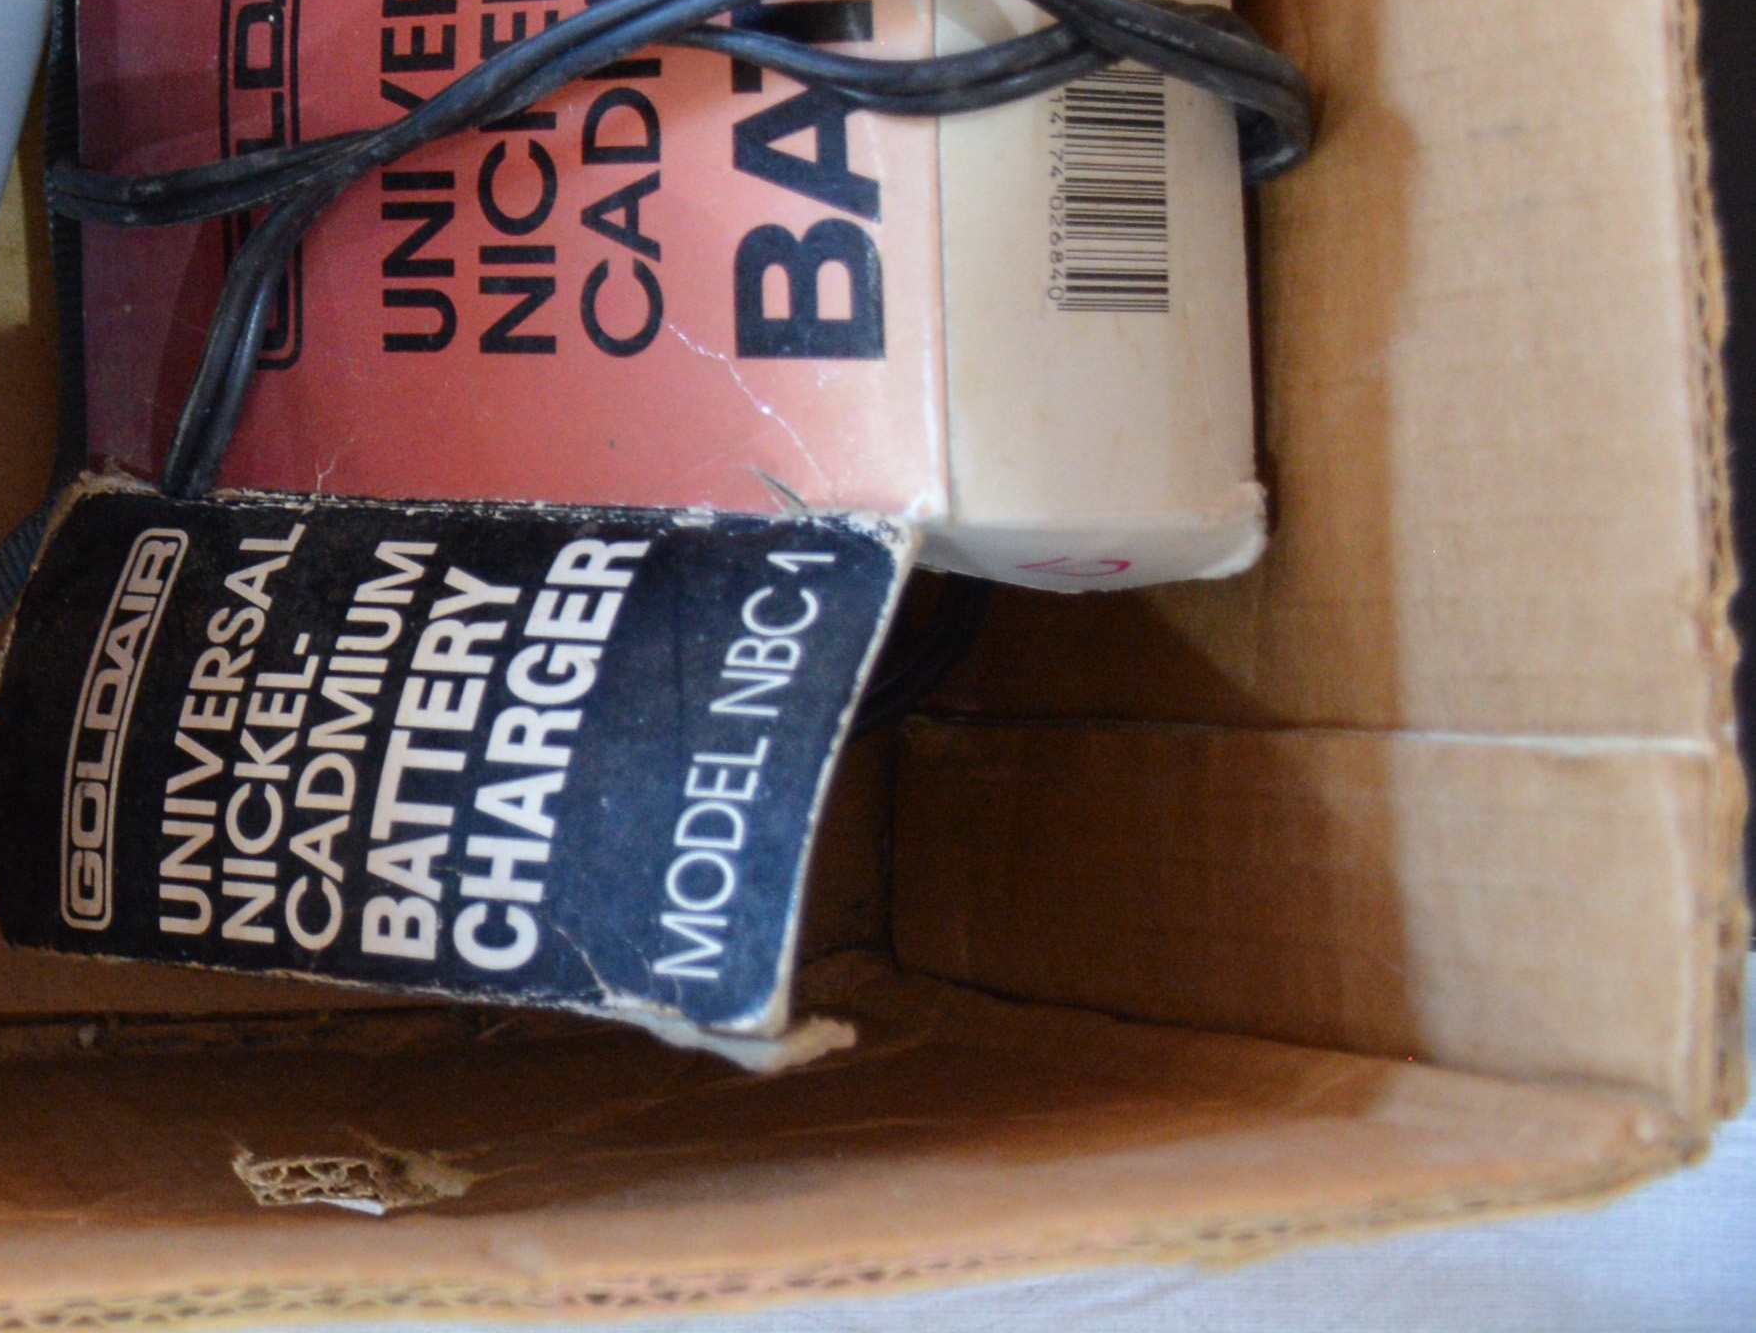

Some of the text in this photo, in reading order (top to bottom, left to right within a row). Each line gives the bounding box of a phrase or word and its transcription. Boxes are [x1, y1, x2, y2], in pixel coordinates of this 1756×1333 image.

[68, 536, 181, 918] GOLDAIR
[159, 523, 306, 935] UNIVERSAL
[220, 630, 322, 945] NICKEL-
[285, 539, 438, 952] CADMIUM
[360, 565, 523, 961] BATTERY
[452, 537, 652, 973] CHARGER
[653, 737, 769, 981] MODEL
